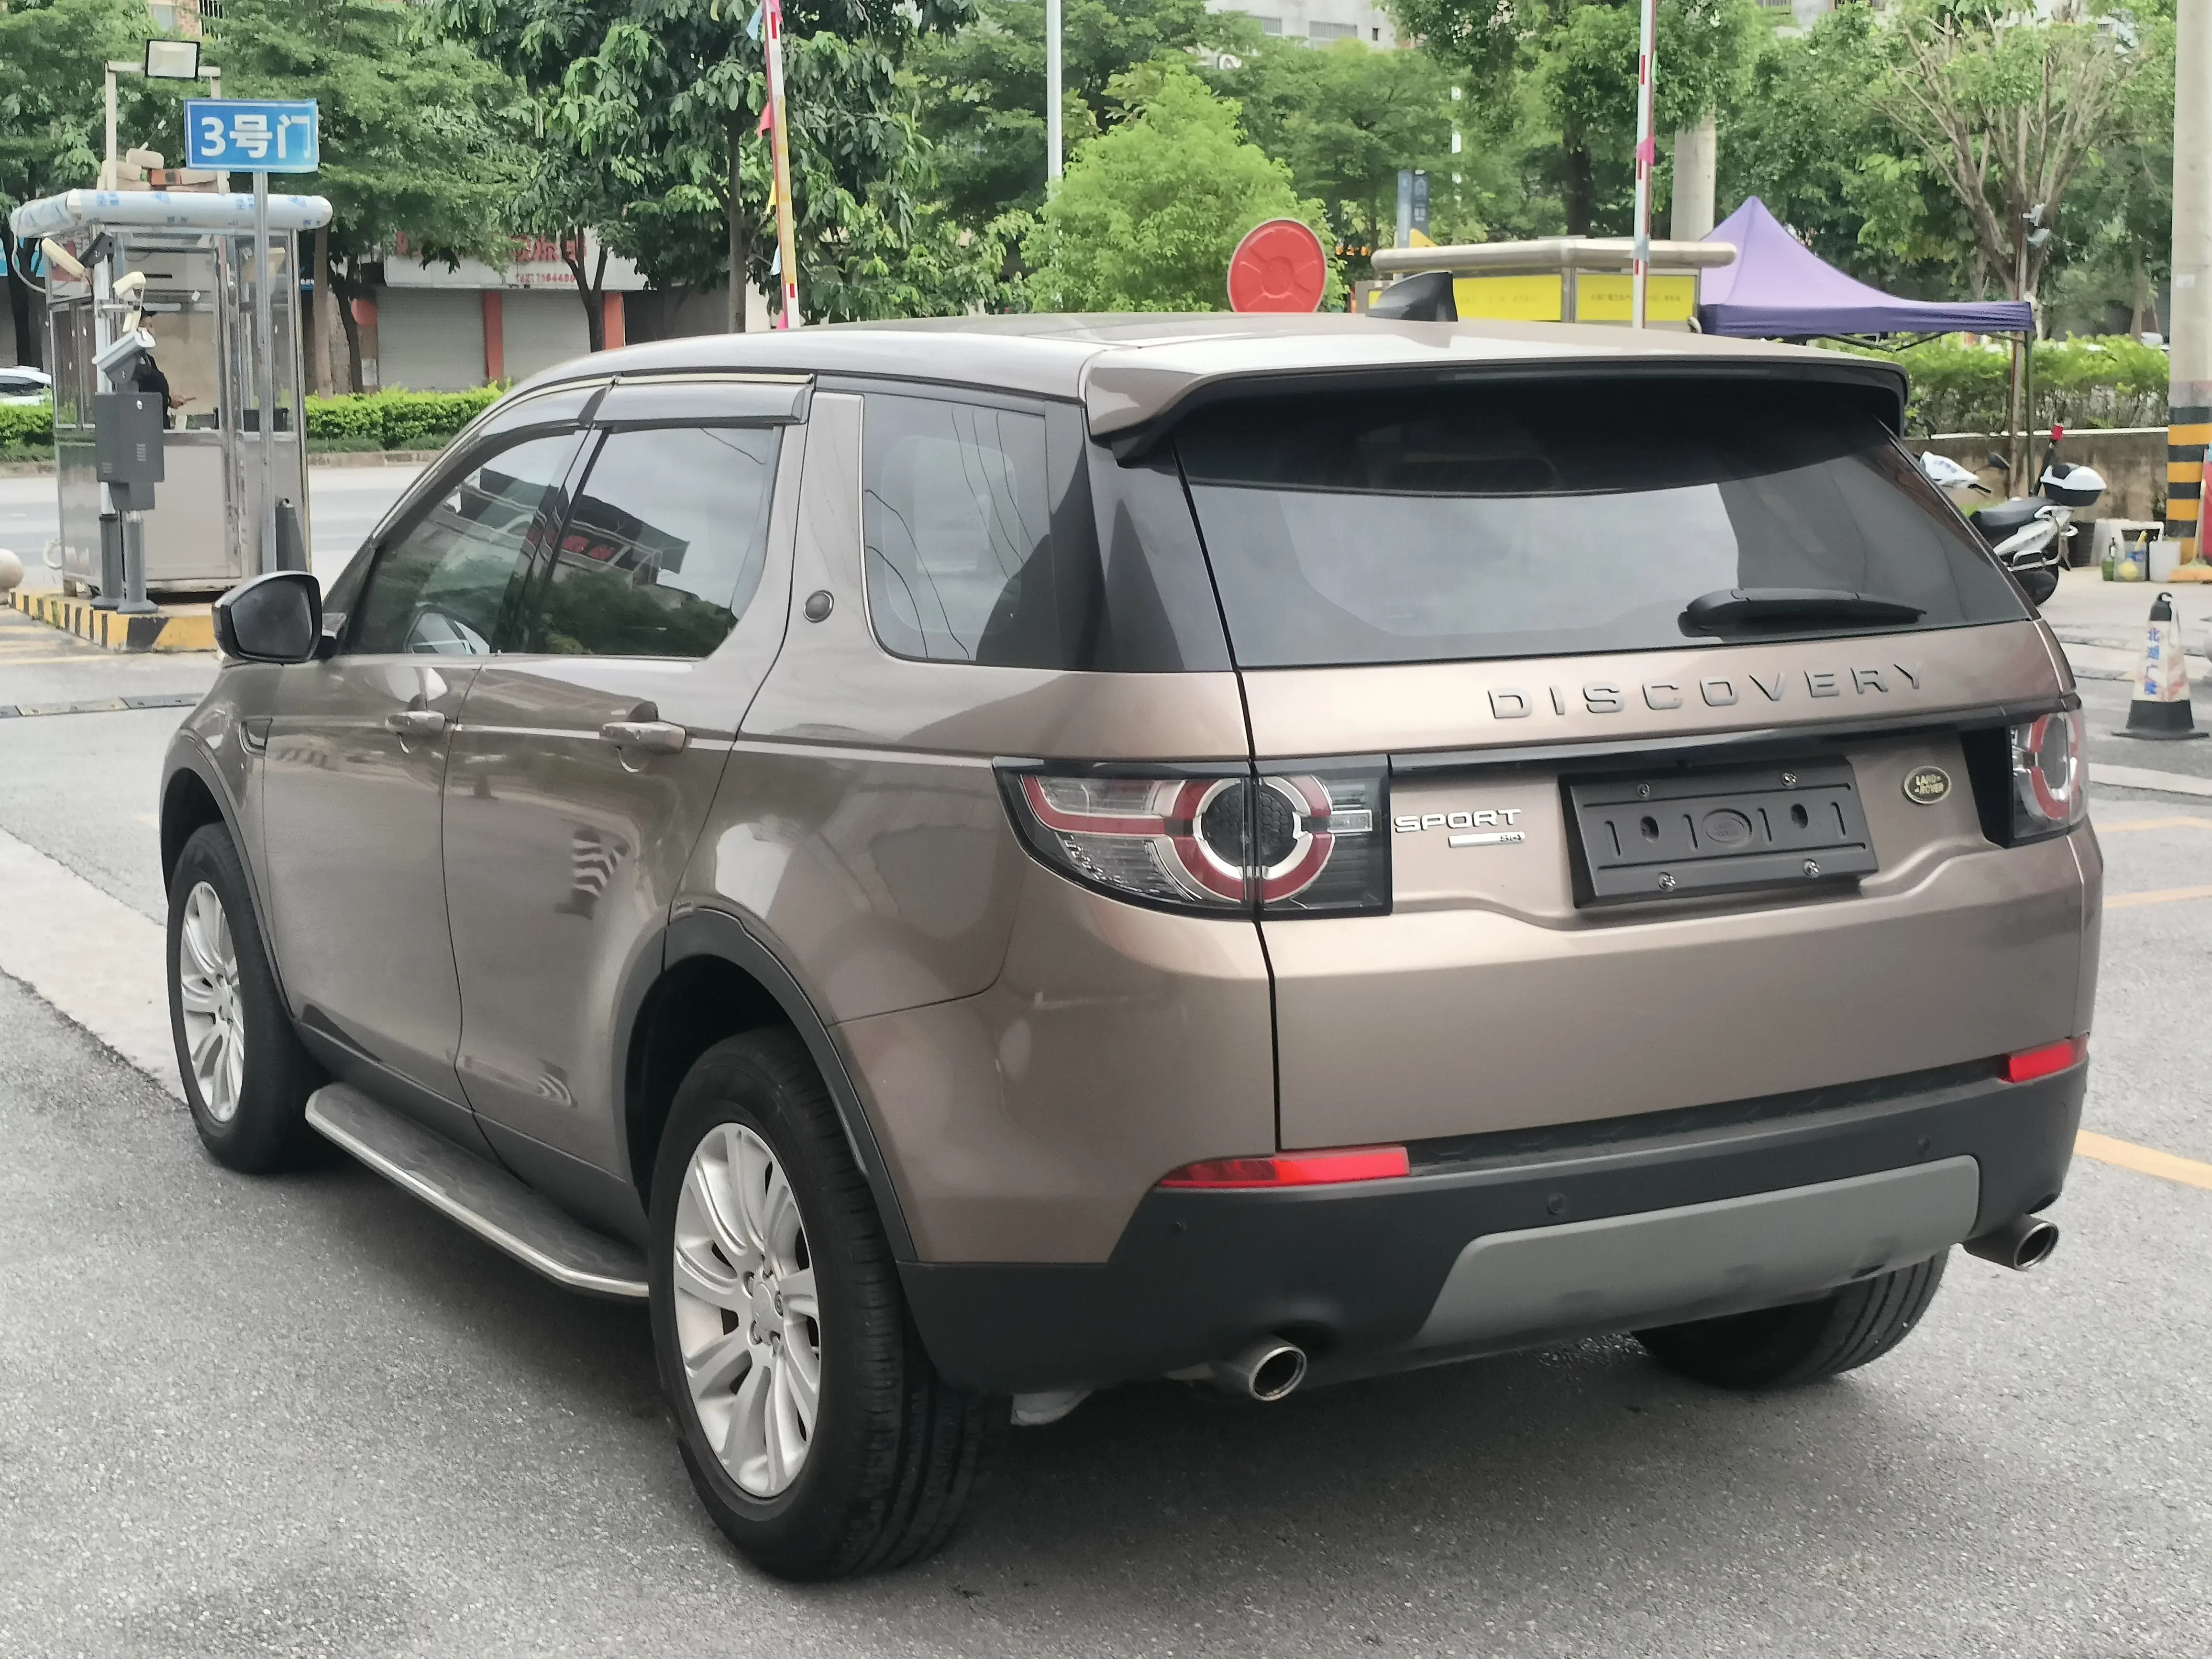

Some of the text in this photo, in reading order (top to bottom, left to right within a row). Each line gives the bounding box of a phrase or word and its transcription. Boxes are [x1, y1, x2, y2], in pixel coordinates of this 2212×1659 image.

[201, 114, 311, 158] 3号门
[1487, 660, 1926, 719] DISCOVERY
[1394, 808, 1522, 833] SPORT
